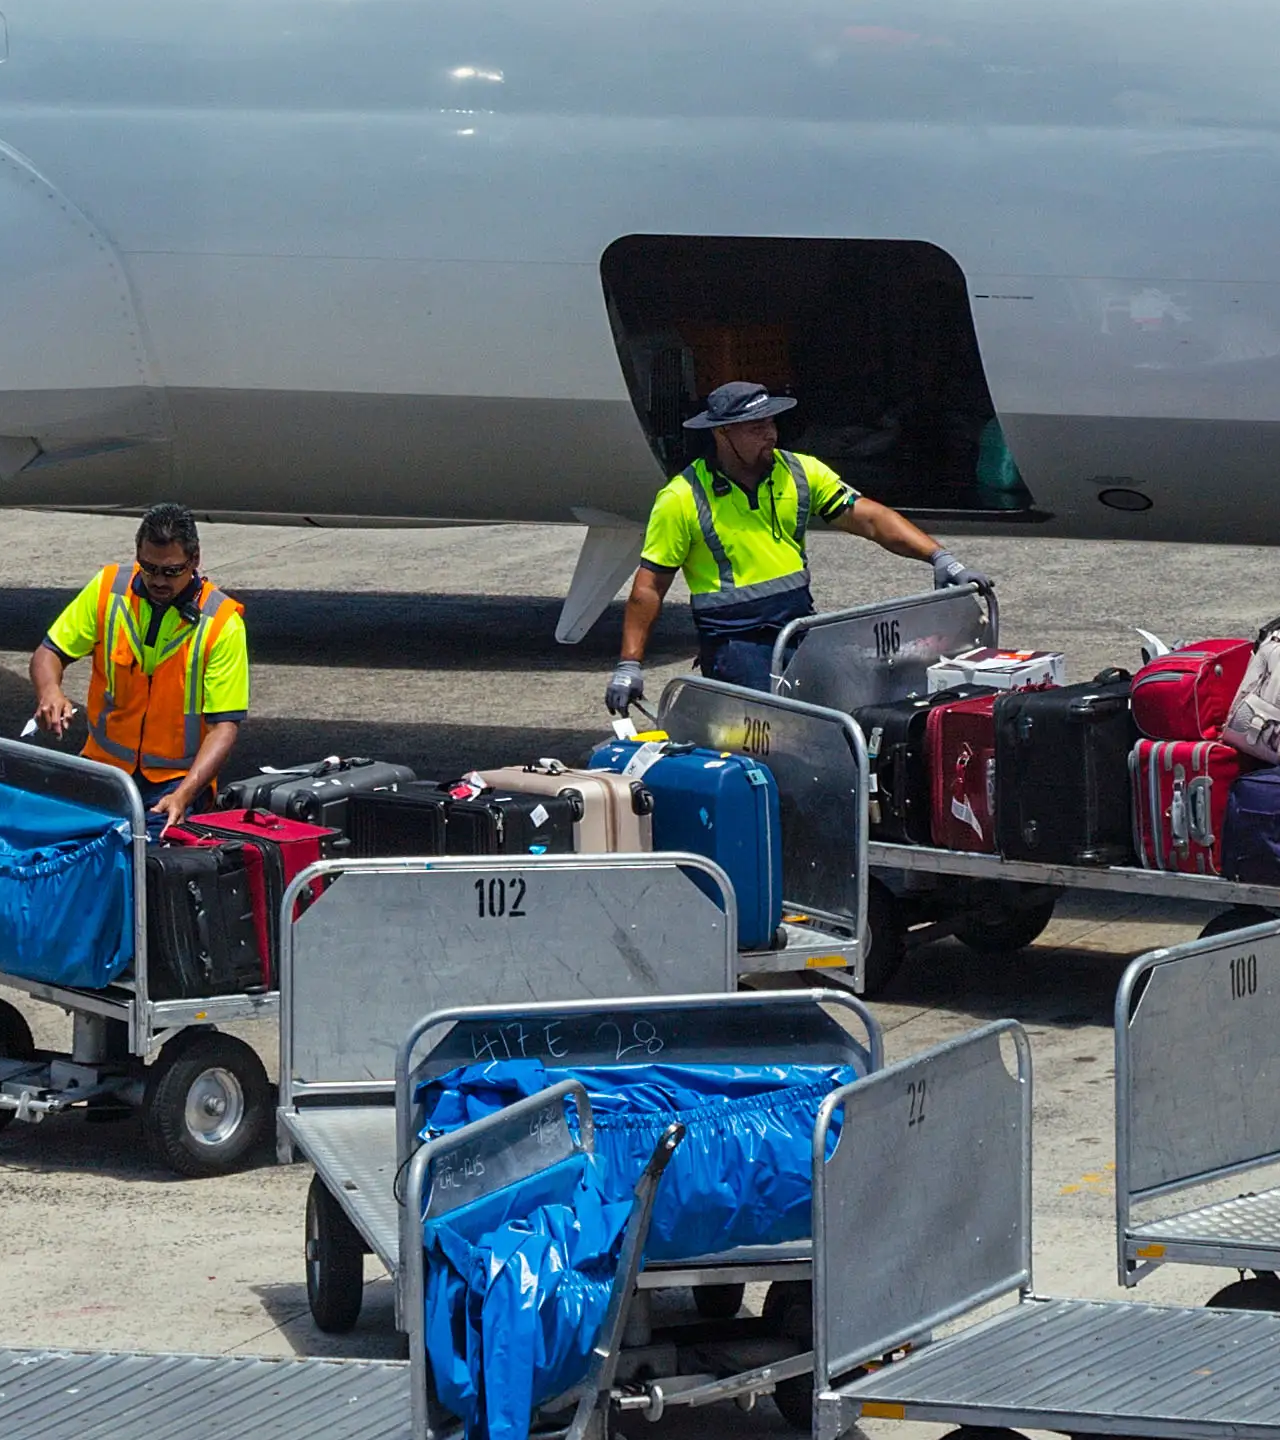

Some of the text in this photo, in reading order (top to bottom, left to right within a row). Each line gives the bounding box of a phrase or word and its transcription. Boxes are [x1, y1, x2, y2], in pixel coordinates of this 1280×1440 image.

[742, 716, 771, 757] 206
[475, 877, 528, 918] 102
[1229, 954, 1258, 1001] 100
[595, 1020, 664, 1061] 28
[907, 1079, 926, 1128] 22
